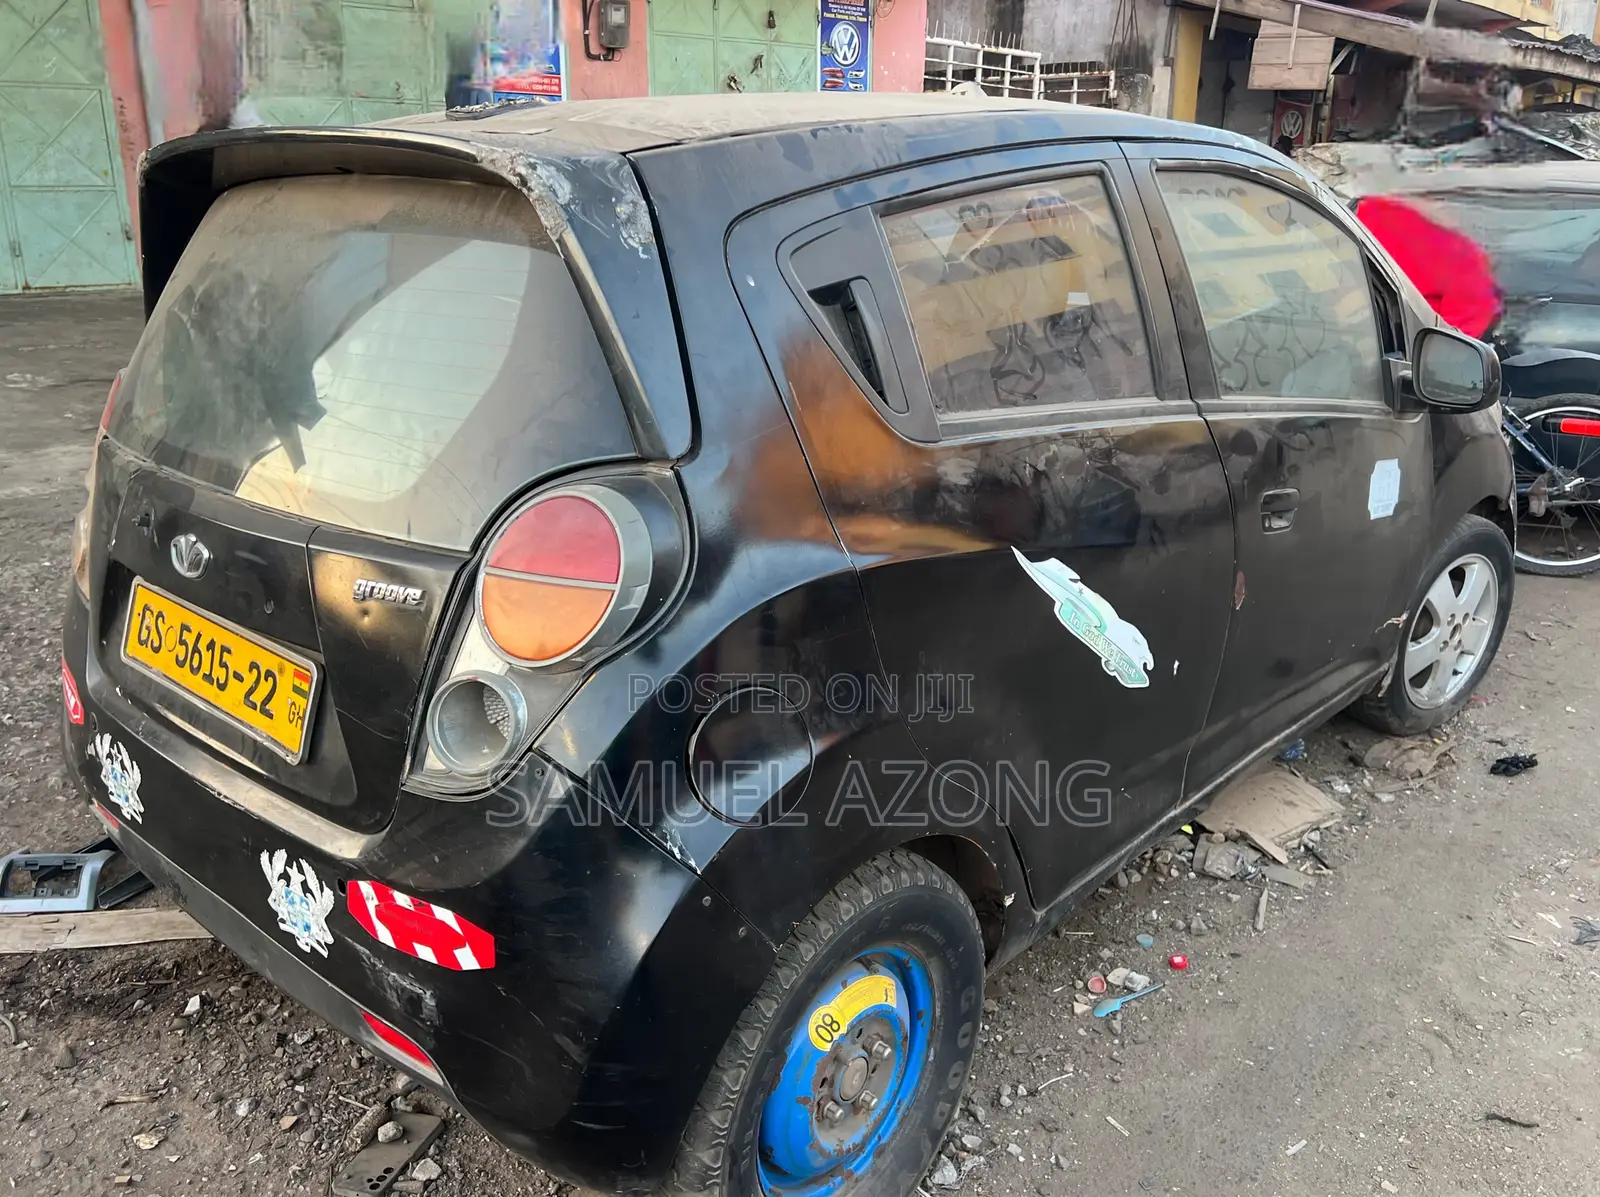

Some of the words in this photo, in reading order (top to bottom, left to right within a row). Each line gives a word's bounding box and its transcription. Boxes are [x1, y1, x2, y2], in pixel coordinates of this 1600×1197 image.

[353, 579, 424, 606] groove
[175, 623, 278, 720] 5615-22
[1070, 611, 1081, 630] In
[1082, 623, 1101, 647] God
[1101, 639, 1114, 657] We
[1113, 652, 1136, 678] Trust
